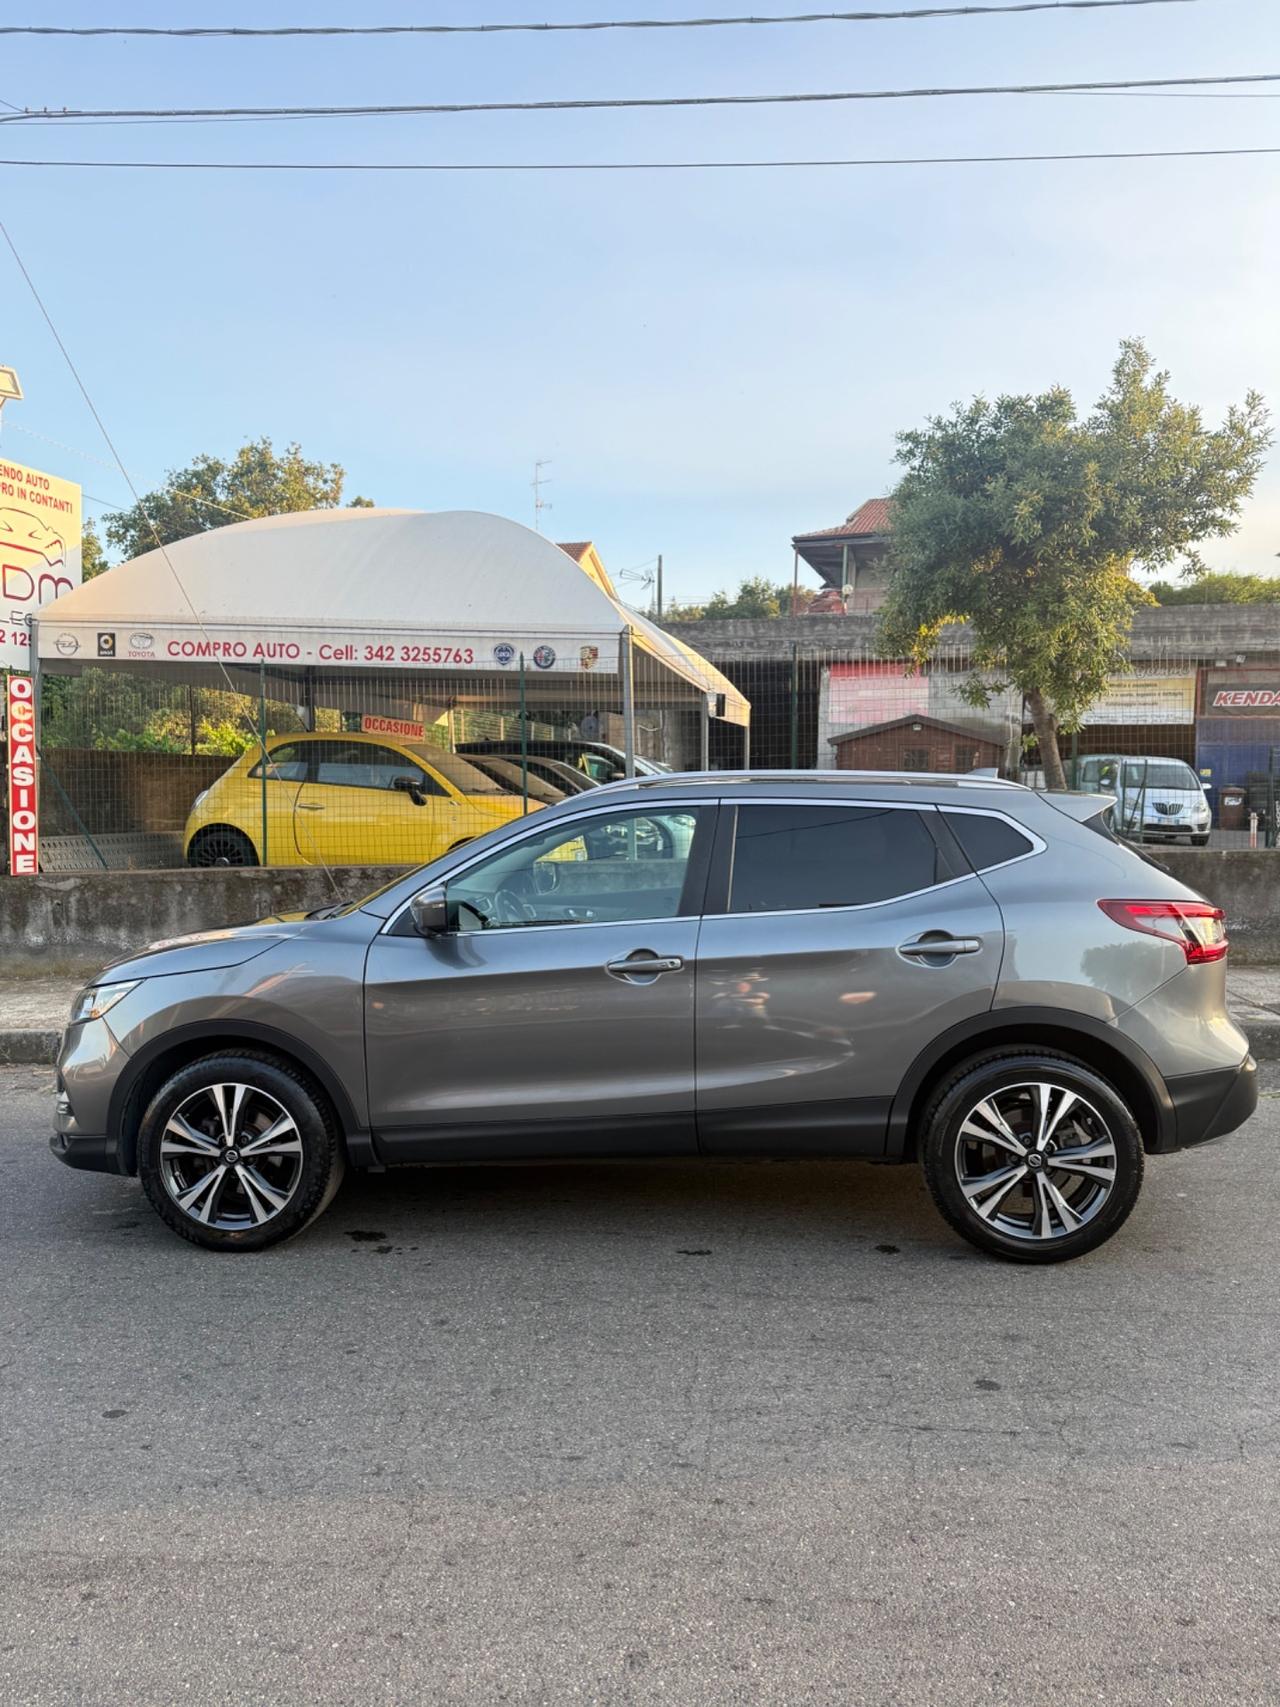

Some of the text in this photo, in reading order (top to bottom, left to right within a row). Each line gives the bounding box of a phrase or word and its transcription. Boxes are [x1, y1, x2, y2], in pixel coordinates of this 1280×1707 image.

[25, 472, 50, 490] AUTO
[17, 486, 27, 500] IN
[29, 490, 73, 514] CONTANTI
[167, 641, 247, 657] COMPRO
[252, 642, 300, 659] AUTO
[319, 644, 358, 661] Cell:
[364, 645, 395, 661] 342
[400, 646, 474, 664] 3255763
[364, 717, 424, 737] OCCASIONE
[9, 678, 36, 873] OCCASIONE
